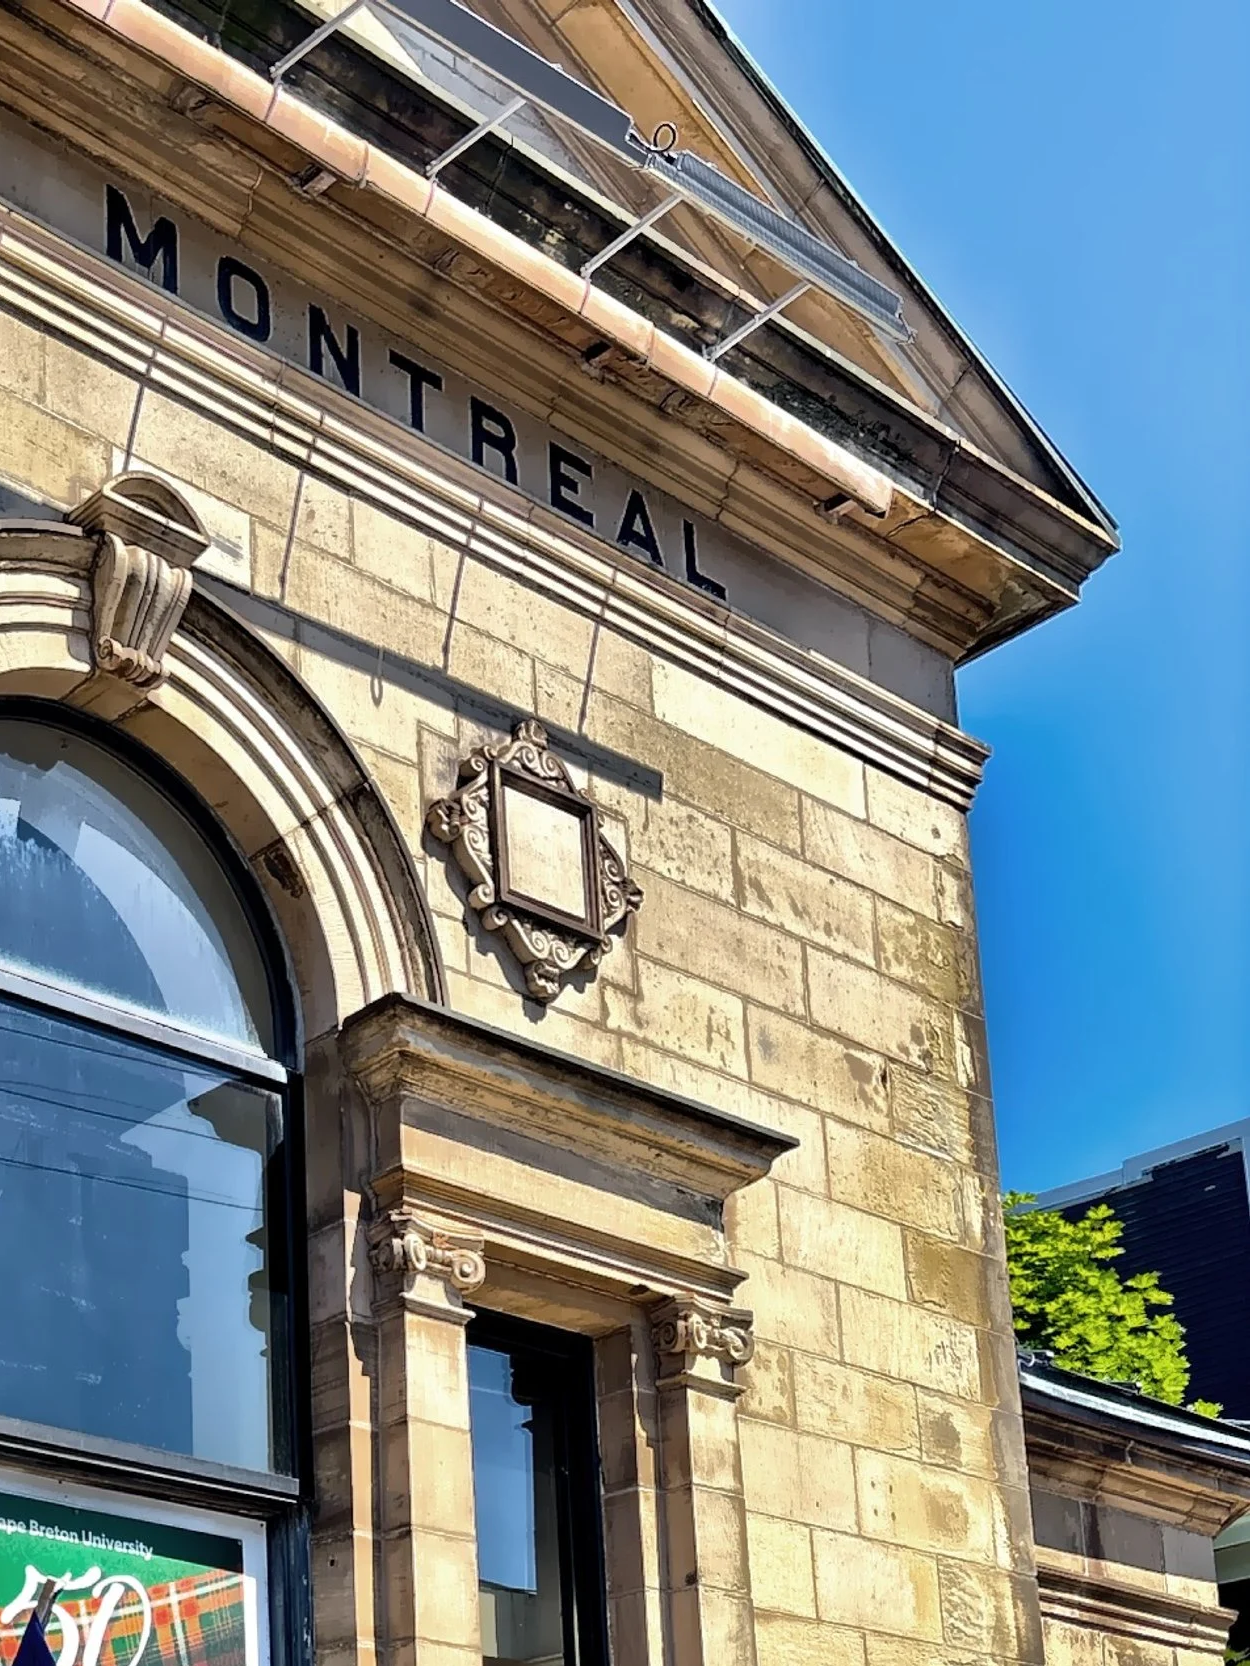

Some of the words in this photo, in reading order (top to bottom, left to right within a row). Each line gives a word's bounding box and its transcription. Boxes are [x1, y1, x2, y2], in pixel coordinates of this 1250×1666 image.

[105, 184, 728, 600] MONTREAL
[29, 1519, 79, 1544] Breton
[81, 1530, 153, 1560] University
